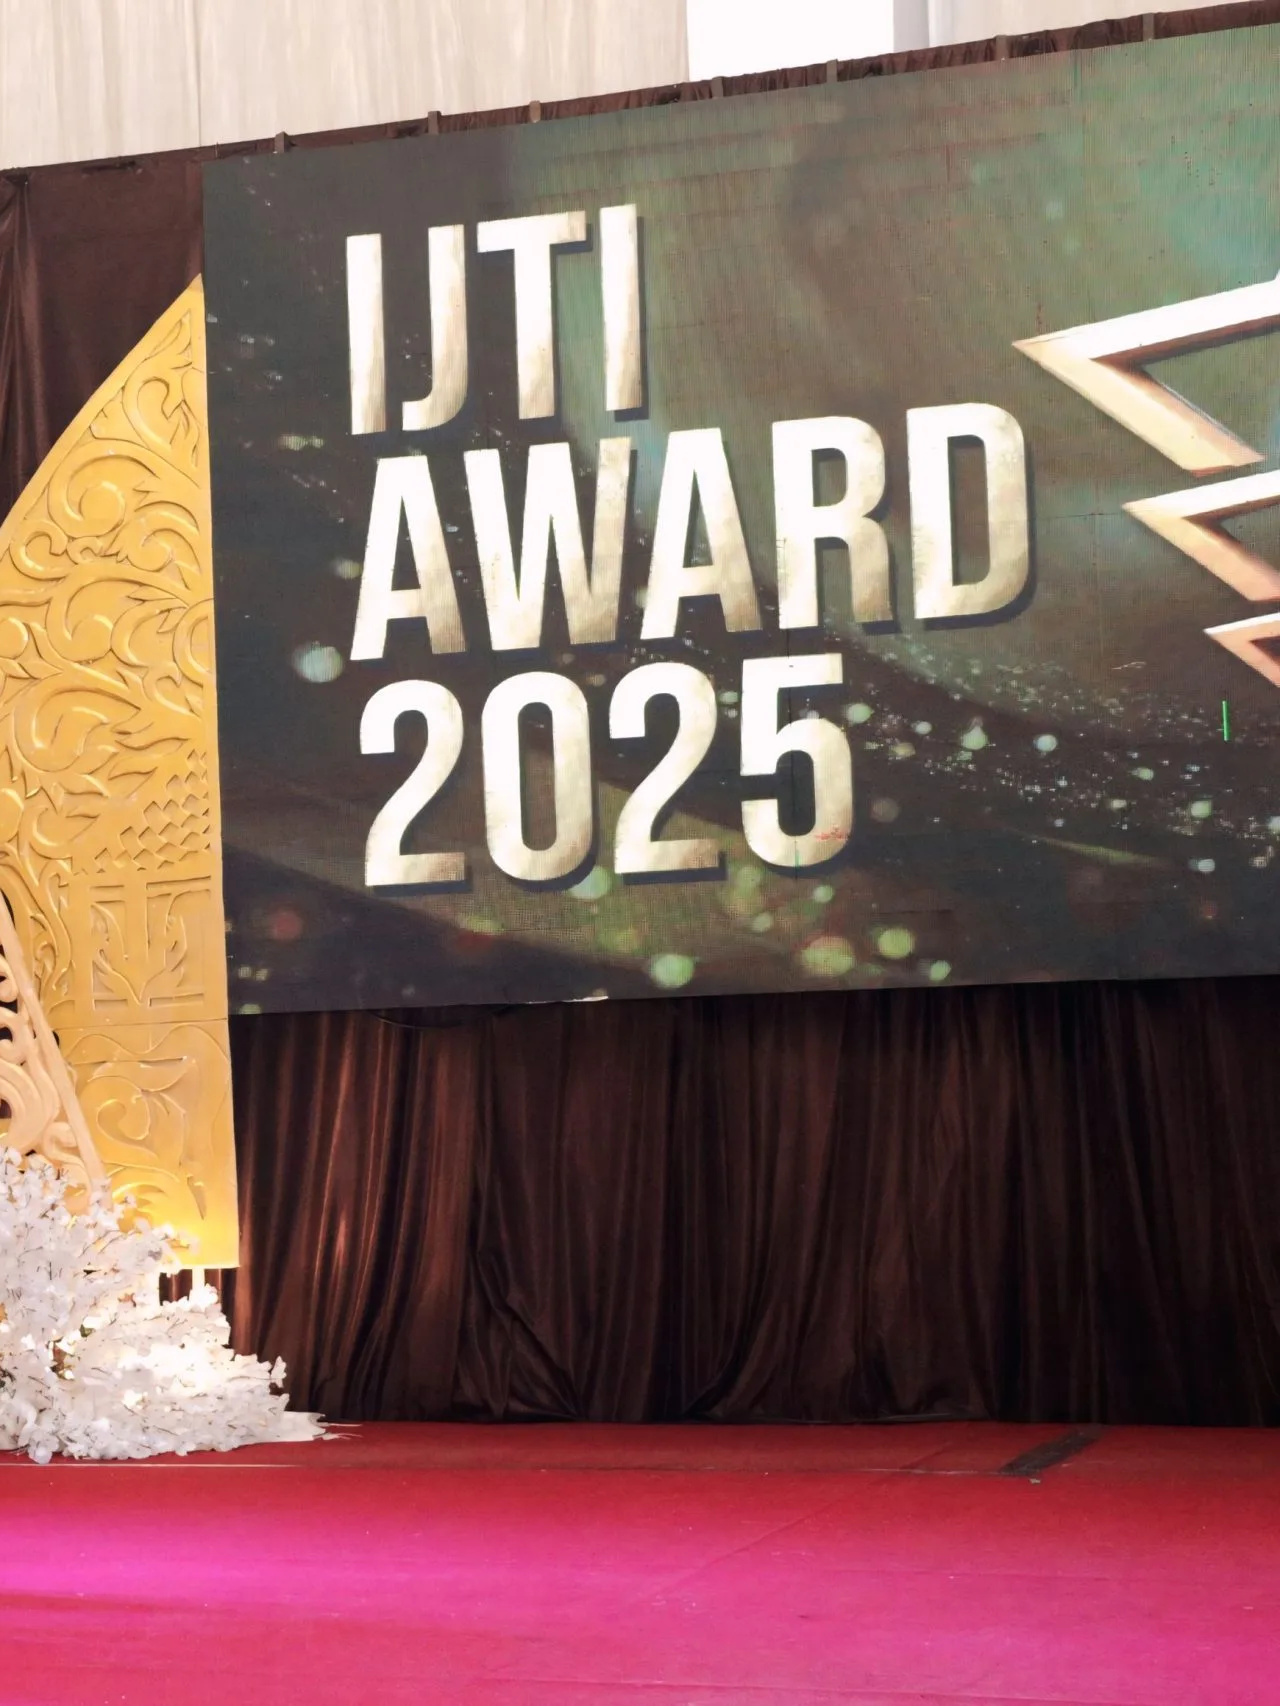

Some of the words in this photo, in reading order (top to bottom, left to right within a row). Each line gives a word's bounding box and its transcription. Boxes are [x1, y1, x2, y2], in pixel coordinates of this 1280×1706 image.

[346, 204, 644, 434] IJTI
[349, 402, 1030, 661] AWARD
[359, 653, 854, 887] 2025
